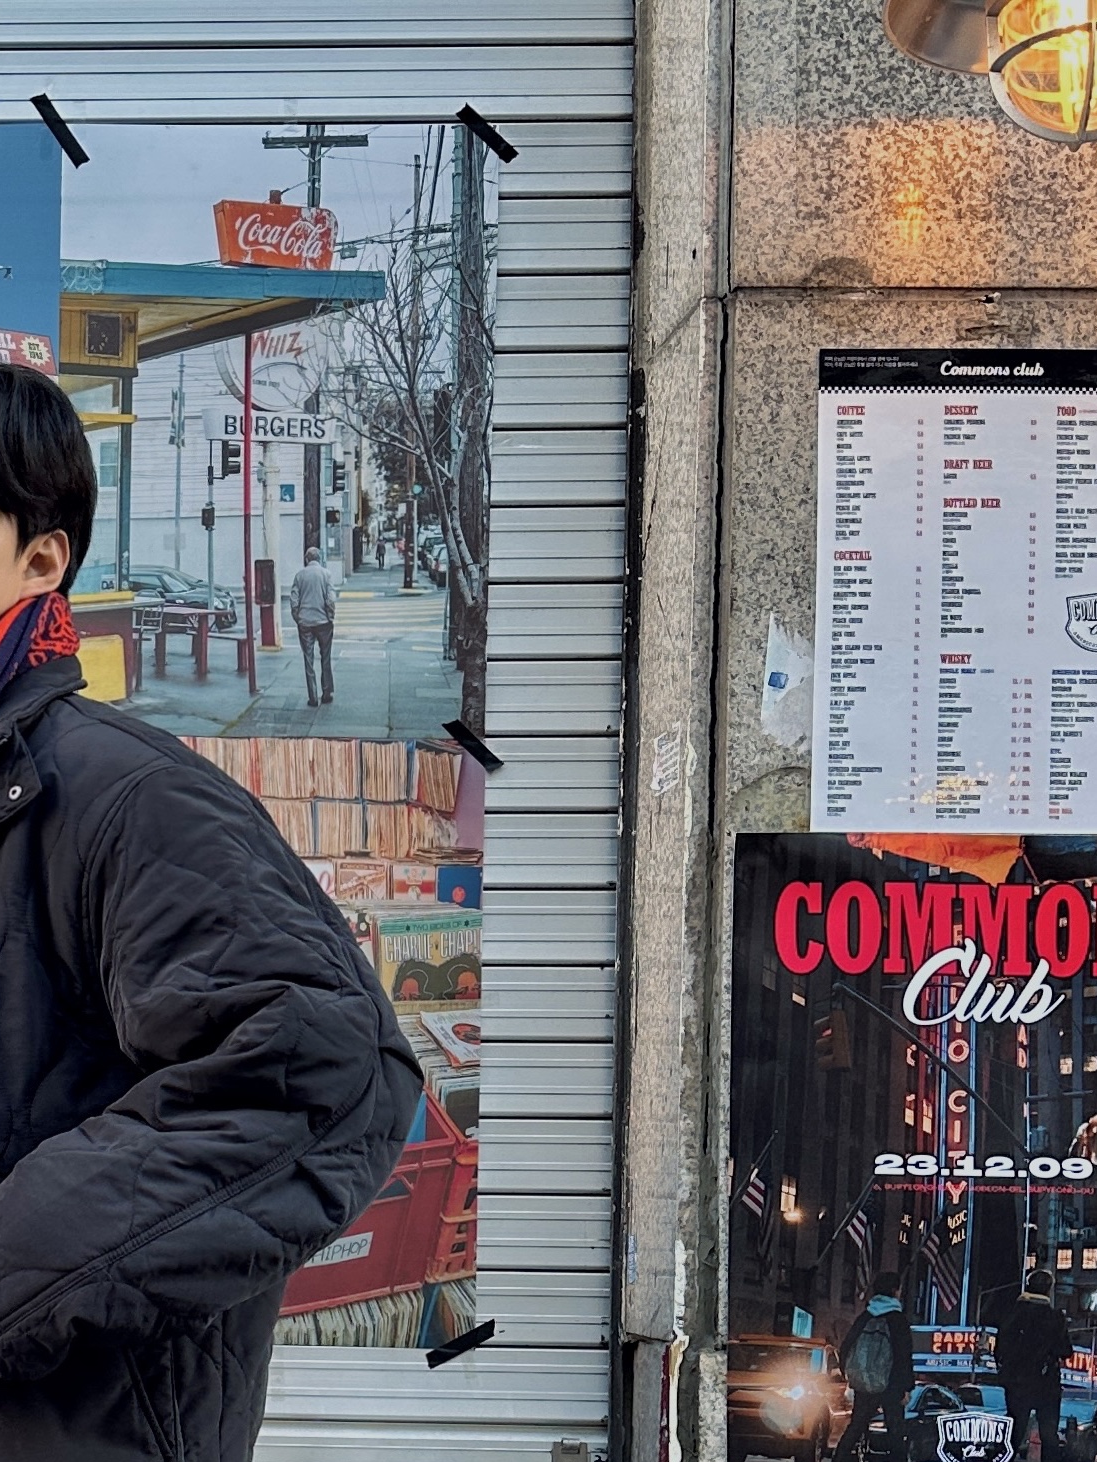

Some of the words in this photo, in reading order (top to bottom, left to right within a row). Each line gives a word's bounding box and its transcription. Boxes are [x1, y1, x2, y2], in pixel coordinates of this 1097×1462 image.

[235, 213, 326, 259] Coca-Cola
[940, 361, 1010, 376] Commons
[1013, 362, 1045, 376] club
[774, 880, 1097, 978] COMMO
[384, 934, 434, 963] CHARLIE
[902, 938, 1066, 1026] Club
[874, 1153, 1093, 1179] 23.12.09
[949, 1228, 966, 1245] ALL
[946, 1418, 1005, 1444] COMMONS
